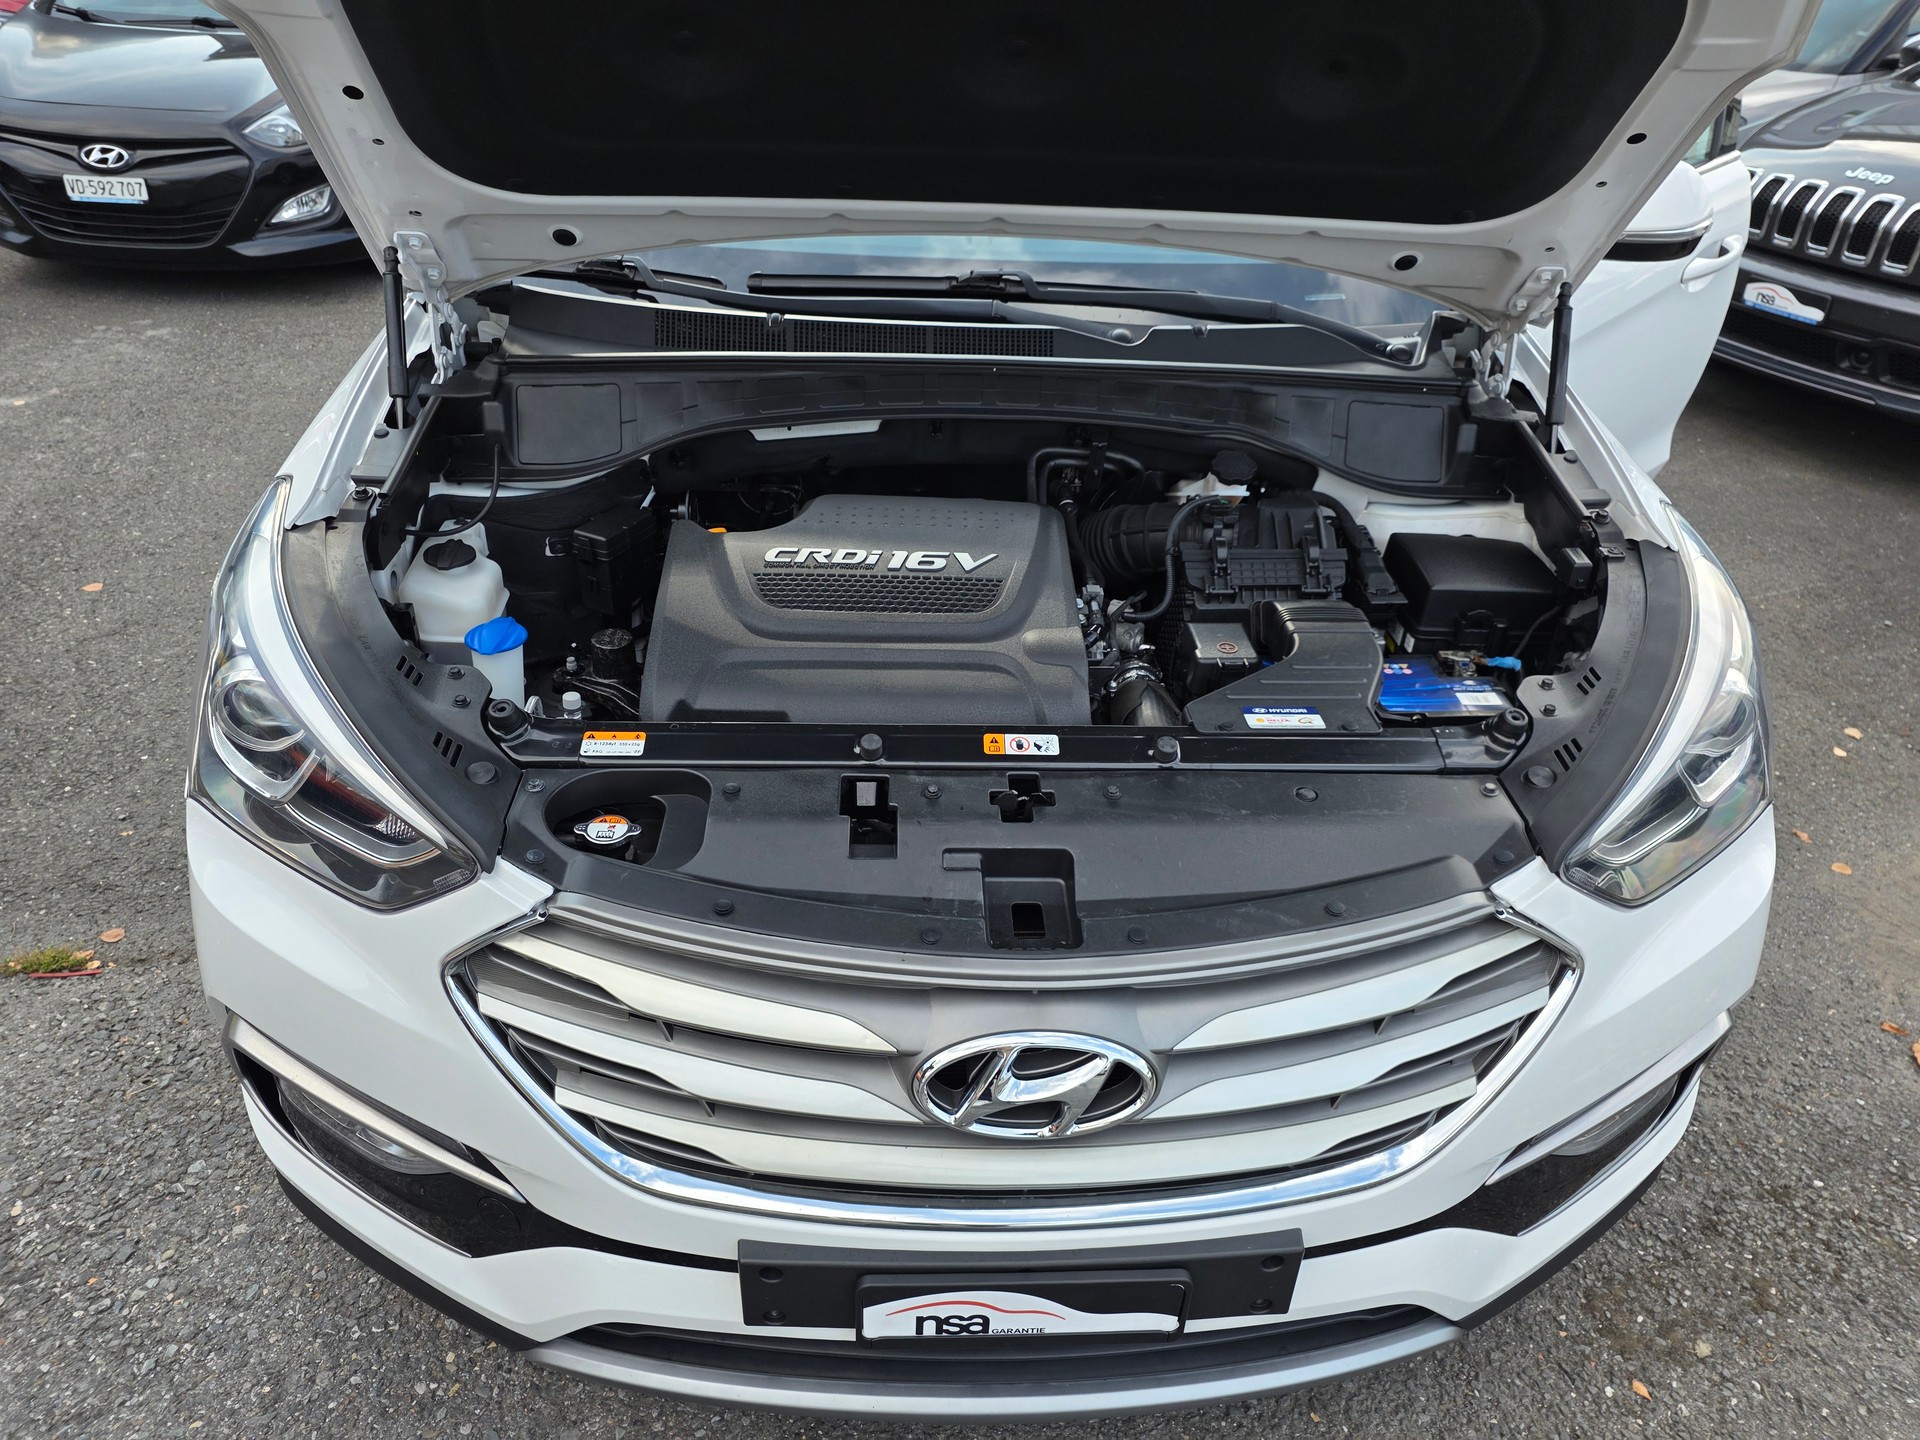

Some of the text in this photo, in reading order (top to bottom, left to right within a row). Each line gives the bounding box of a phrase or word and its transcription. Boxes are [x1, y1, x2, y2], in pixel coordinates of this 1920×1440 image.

[1845, 166, 1895, 185] Jeep
[764, 547, 999, 572] CRDi 16V
[915, 1314, 1046, 1336] nsa GARANTIE
